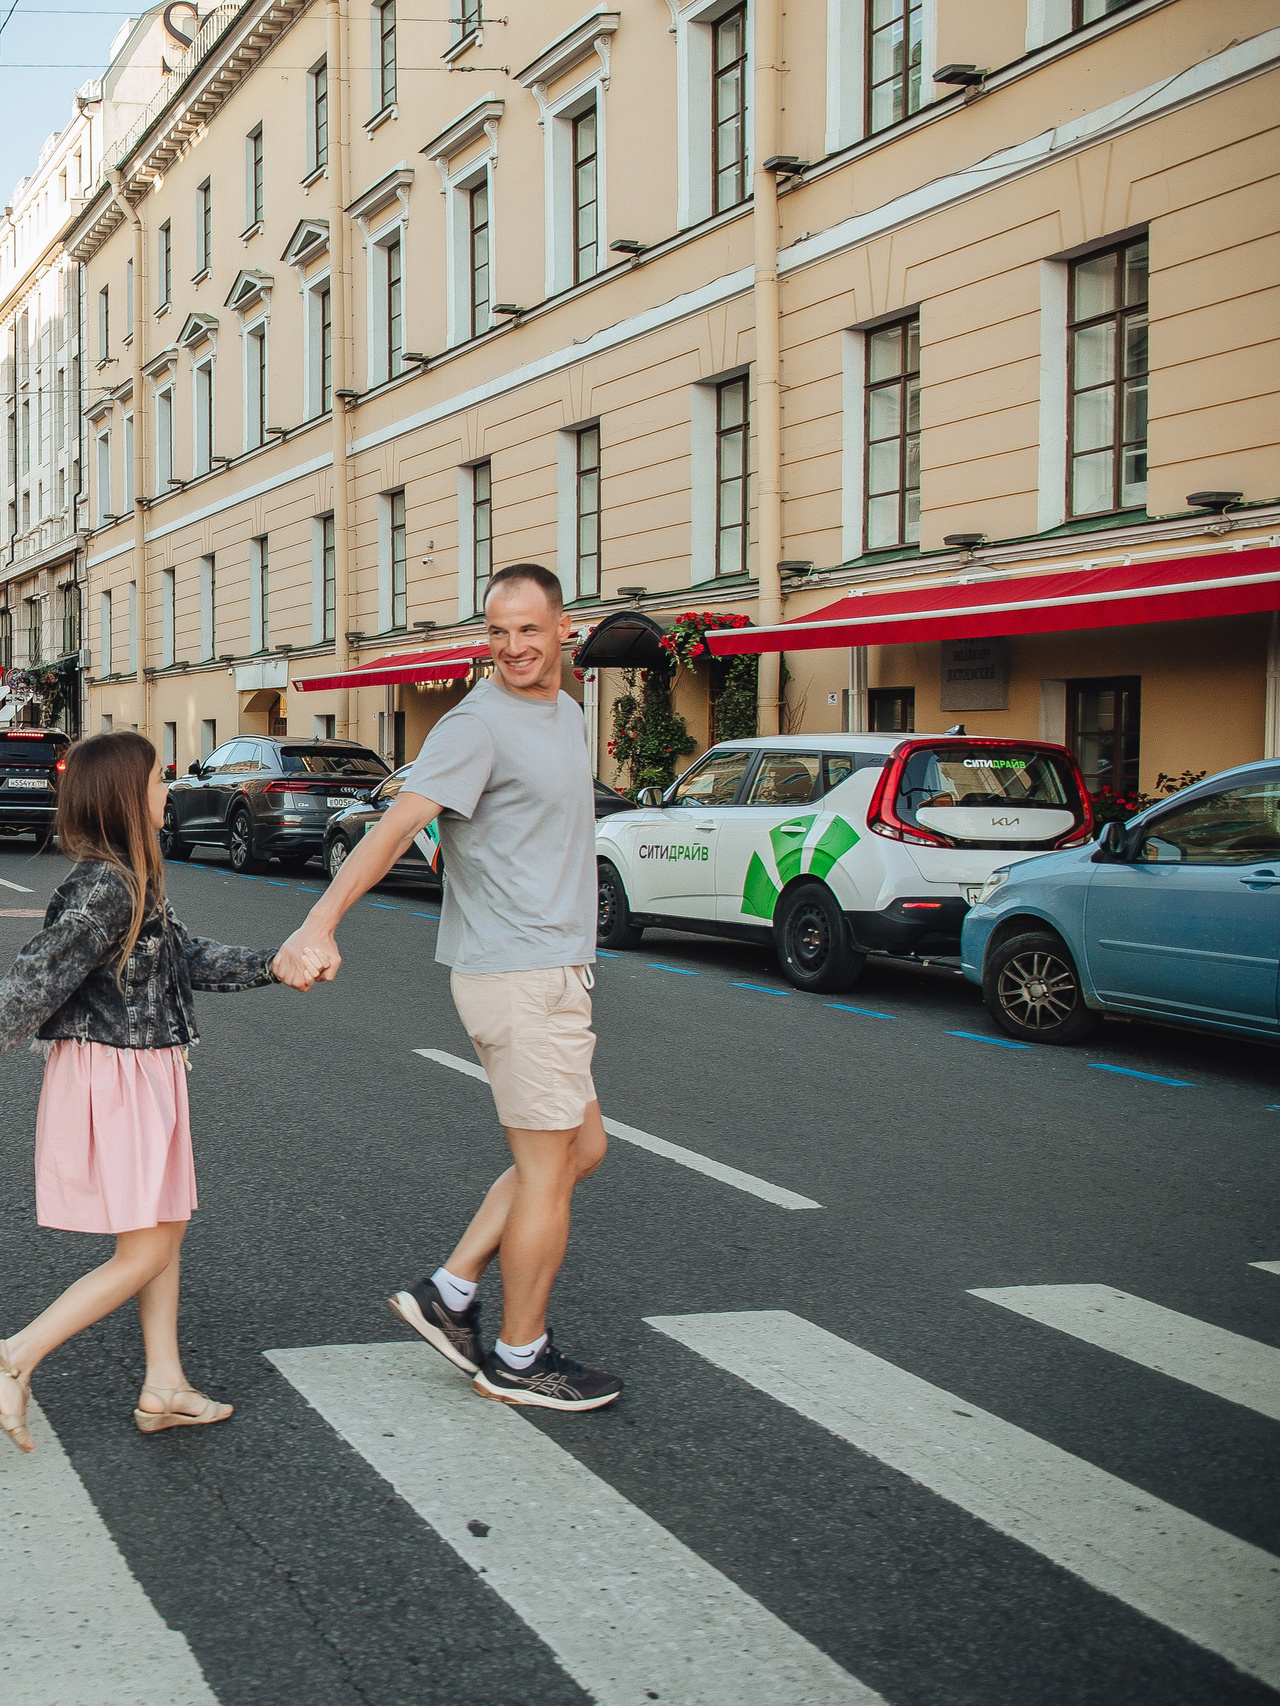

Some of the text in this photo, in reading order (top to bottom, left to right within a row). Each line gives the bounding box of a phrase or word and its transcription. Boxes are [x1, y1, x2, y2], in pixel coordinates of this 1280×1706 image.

[963, 758, 1026, 769] СИТИДРАЙВ
[991, 817, 1020, 826] KIA
[638, 842, 710, 863] СИТИДРАЙВ
